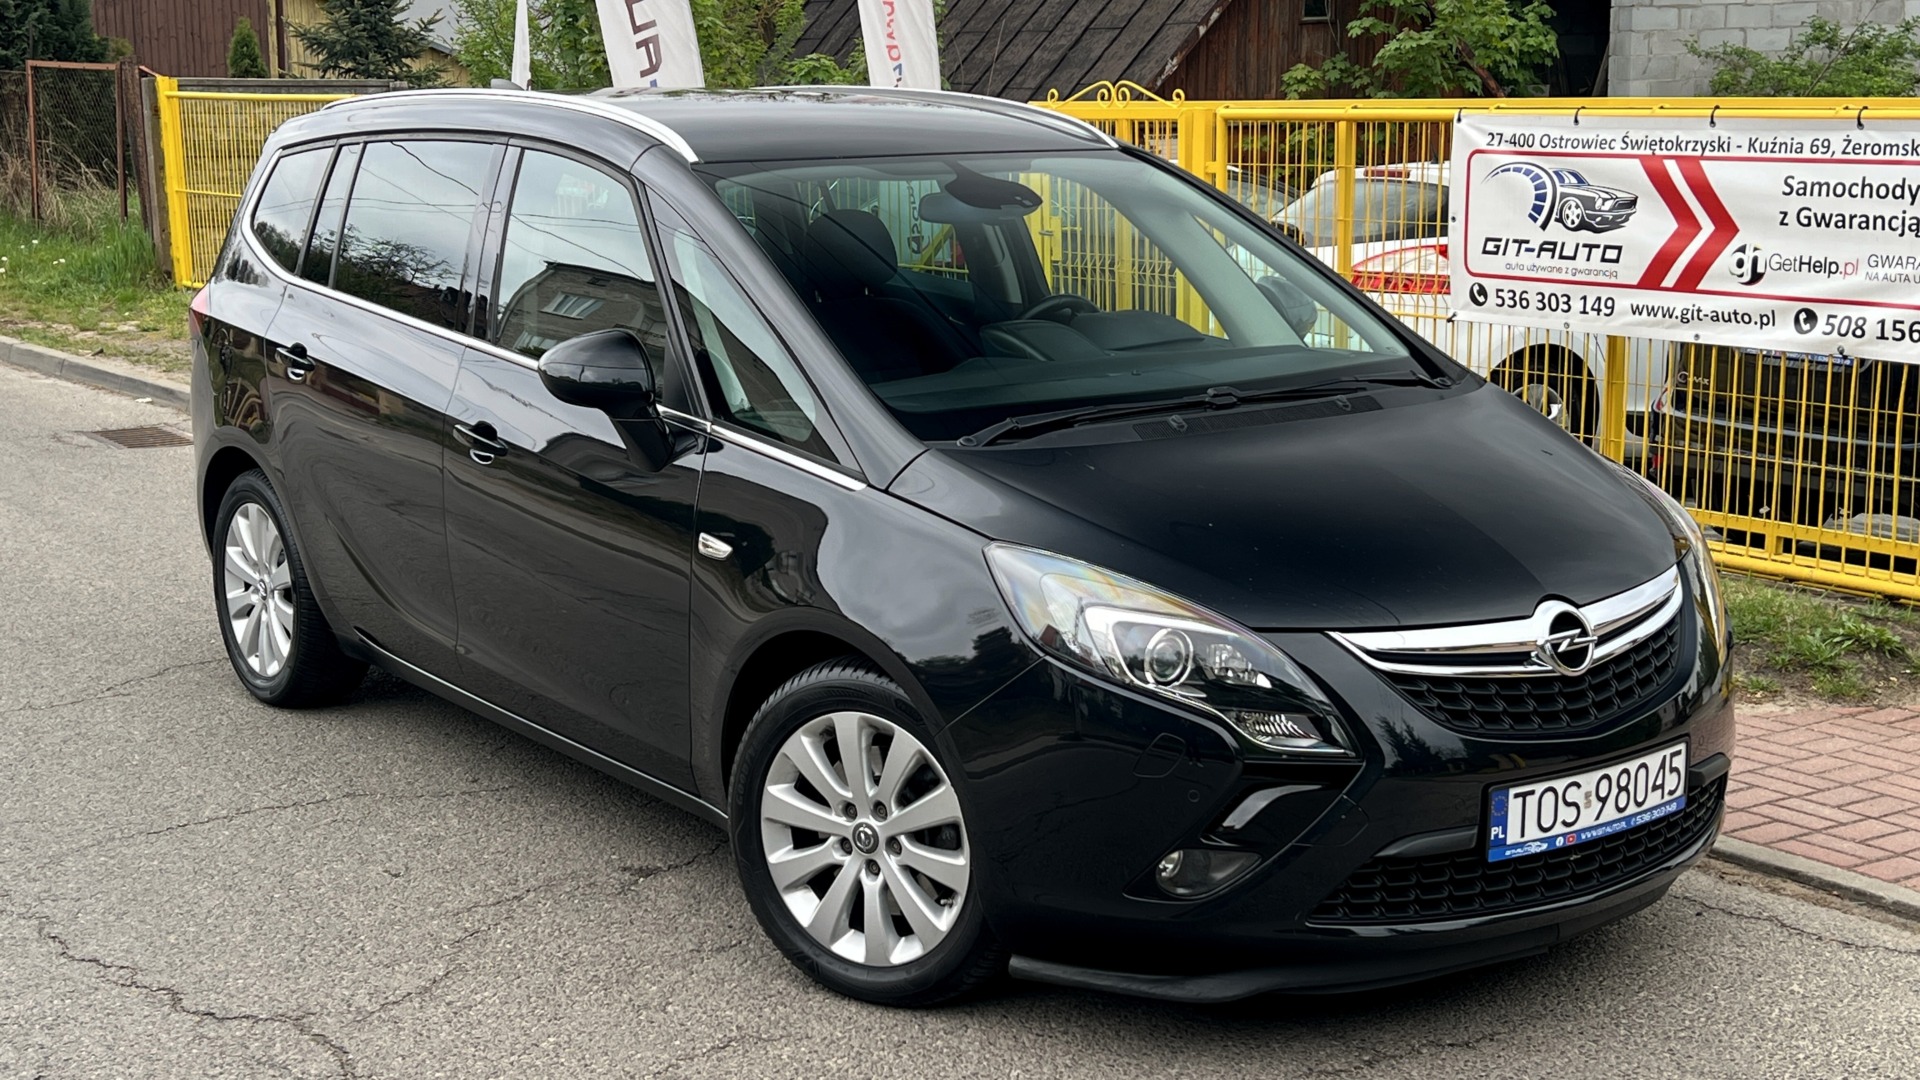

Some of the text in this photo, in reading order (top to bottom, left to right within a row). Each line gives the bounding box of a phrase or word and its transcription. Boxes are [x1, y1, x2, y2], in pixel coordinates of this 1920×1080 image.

[1486, 131, 1535, 148] 27-400
[1539, 133, 1616, 150] Ostrowiec
[1621, 131, 1732, 157] Świętokrzyski
[1747, 136, 1804, 155] Kuźnia
[1809, 137, 1836, 158] 69,
[1841, 134, 1920, 157] Żeromsk
[1781, 175, 1920, 206] Samochody
[1778, 206, 1920, 239] z Gwarancją
[1481, 236, 1623, 264] GIT-AUTO
[1505, 262, 1525, 271] auta
[1526, 263, 1563, 273] używane
[1571, 267, 1618, 279] gwarancją
[1768, 252, 1859, 279] GetHelp.pl
[1864, 271, 1880, 282] NA
[1881, 272, 1911, 284] AUTA
[1495, 288, 1616, 317] 536 303 149
[1630, 302, 1776, 330] www.git-auto.pl
[1821, 314, 1920, 343] 508 156
[1513, 749, 1683, 839] TOS 98045
[1490, 826, 1505, 841] PL
